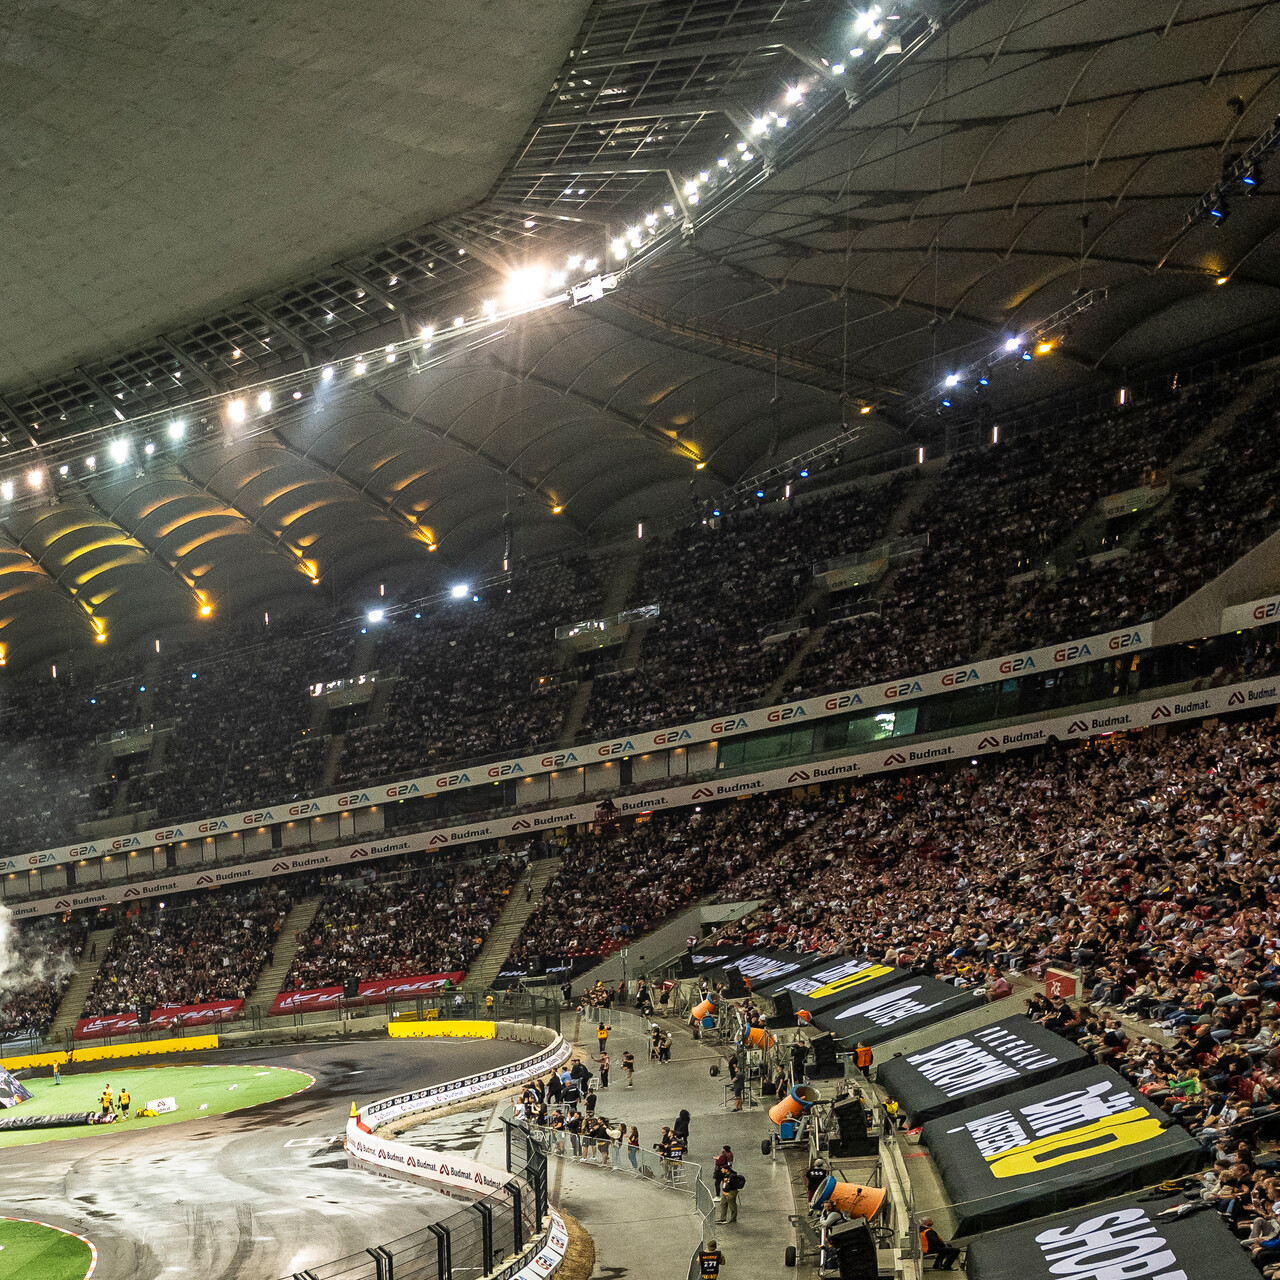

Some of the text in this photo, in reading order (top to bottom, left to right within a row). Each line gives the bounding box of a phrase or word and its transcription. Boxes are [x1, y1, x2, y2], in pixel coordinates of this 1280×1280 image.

[1109, 632, 1141, 650] G2A
[1054, 645, 1090, 662] G2A
[1000, 657, 1035, 673] G2A
[942, 670, 978, 686] G2A
[884, 682, 922, 698] G2A
[825, 694, 862, 710] G2A
[767, 707, 806, 722] G2A
[711, 719, 747, 733] G2A
[654, 730, 690, 744] G2A
[598, 742, 634, 756] G2A
[542, 753, 577, 767] G2A
[488, 764, 523, 777] G2A
[436, 774, 470, 787] G2A
[386, 784, 419, 797] G2A
[338, 794, 369, 806] G2A
[243, 812, 273, 824] G2A
[198, 821, 227, 833] G2A
[155, 829, 183, 841] G2A
[70, 846, 97, 857] G2A
[29, 854, 55, 864] G2A
[1020, 1080, 1135, 1136] Drift
[965, 1110, 1031, 1157] MASTERS
[363, 1144, 376, 1156] Budmat.
[387, 1152, 404, 1163] Budmat.
[417, 1159, 437, 1171] Budmat.
[451, 1167, 472, 1180] Budmat.
[535, 1253, 557, 1270] G2A
